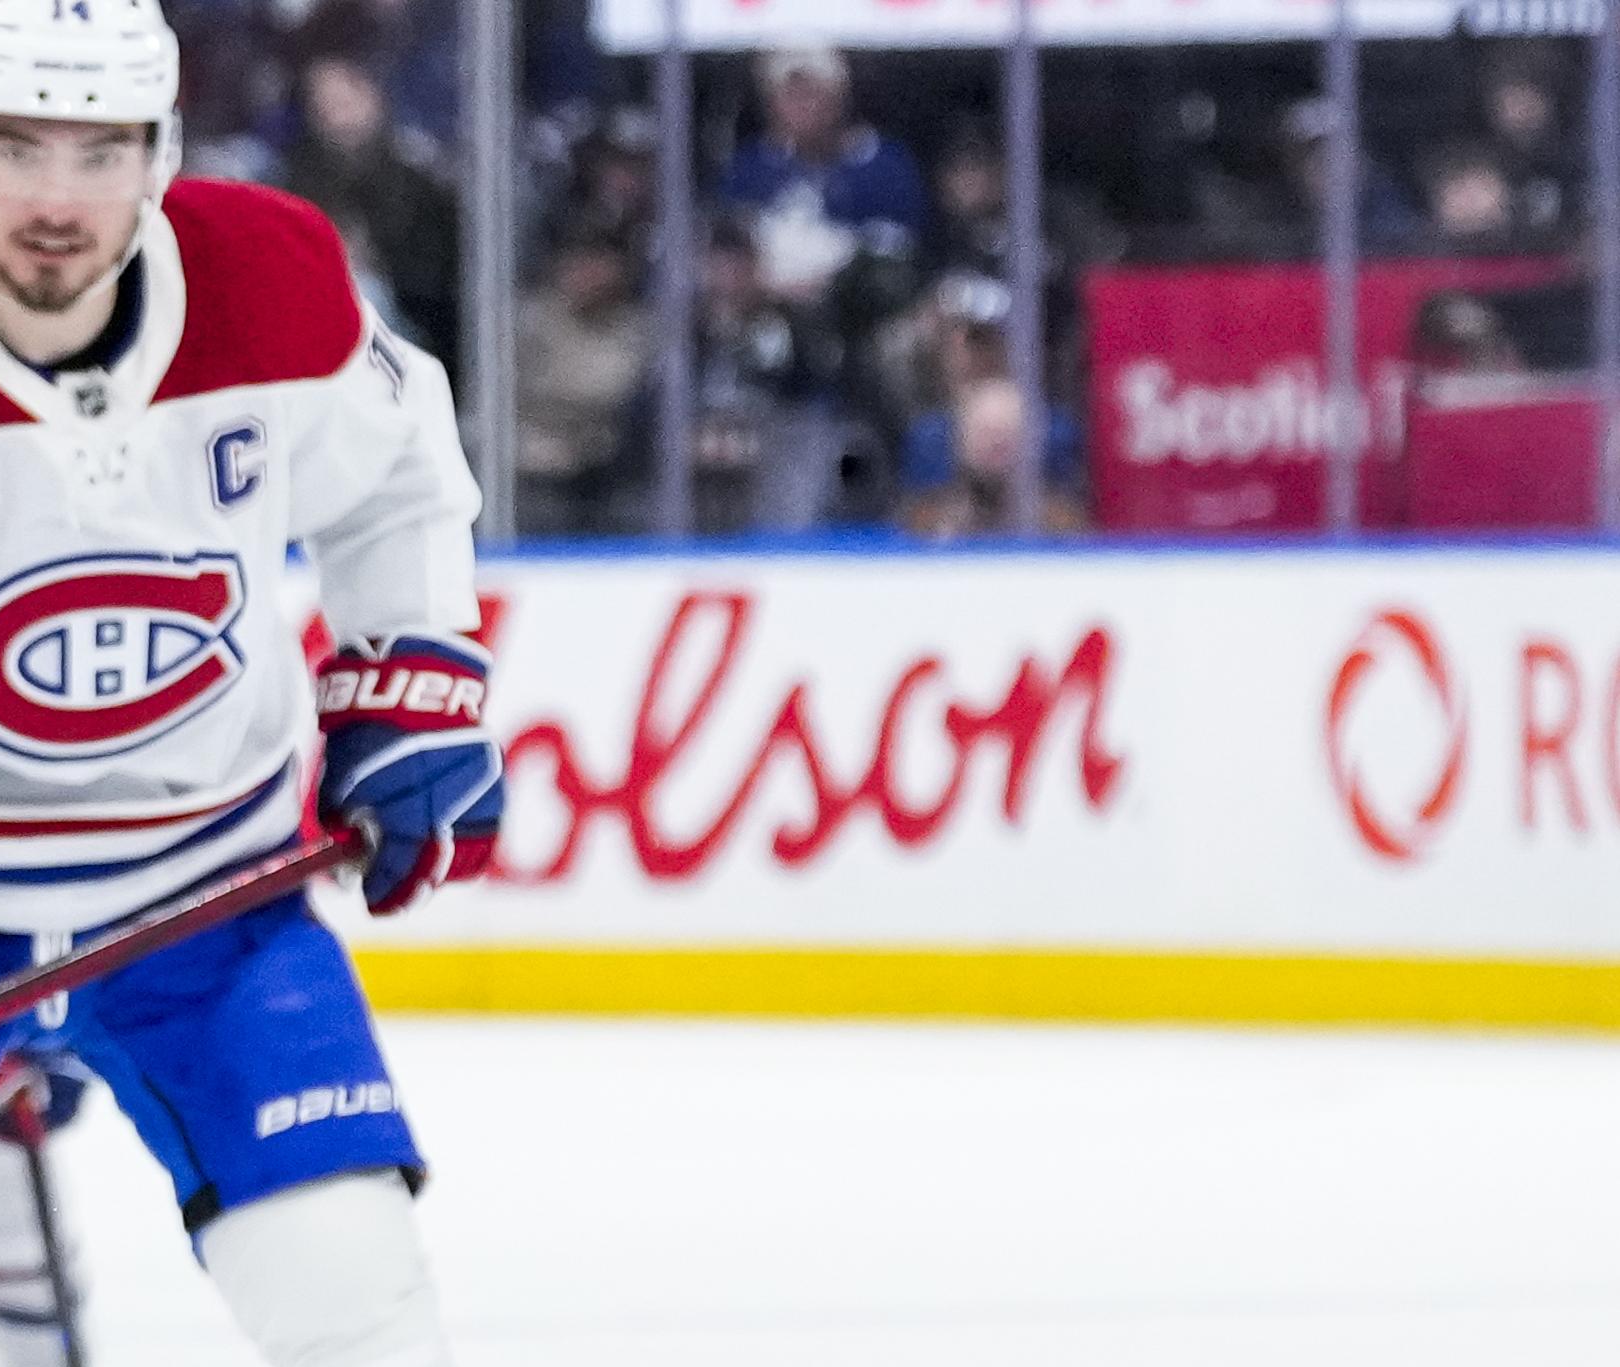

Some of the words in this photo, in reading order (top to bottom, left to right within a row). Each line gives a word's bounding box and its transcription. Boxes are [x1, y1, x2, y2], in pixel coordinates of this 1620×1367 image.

[206, 417, 267, 512] C
[301, 592, 1125, 886] olson
[256, 1079, 398, 1138] BAUE
